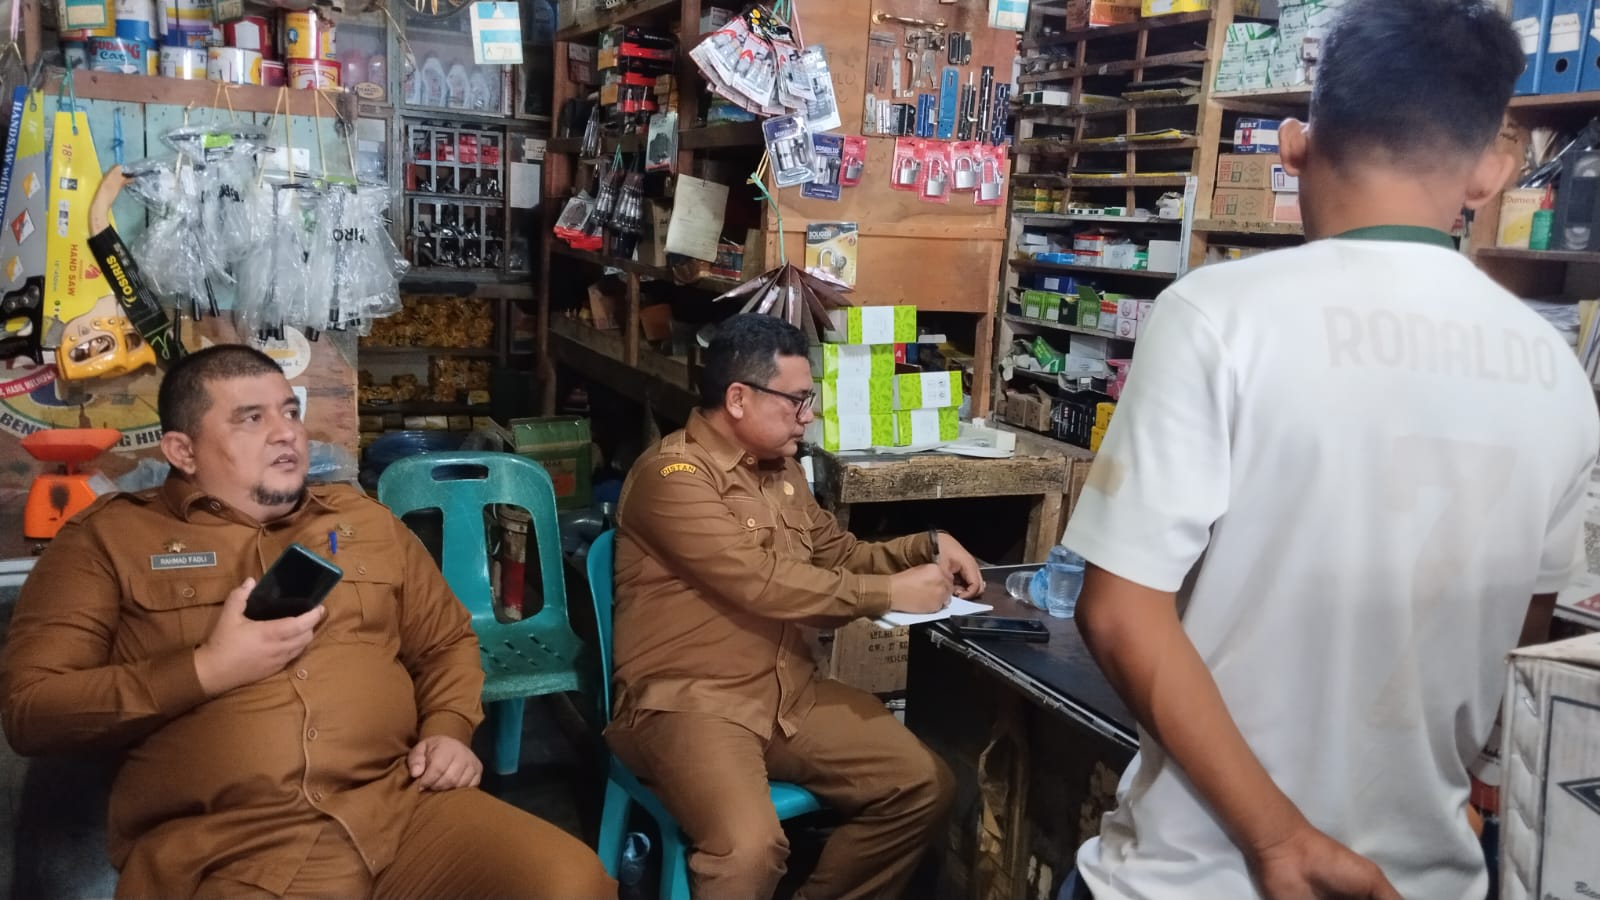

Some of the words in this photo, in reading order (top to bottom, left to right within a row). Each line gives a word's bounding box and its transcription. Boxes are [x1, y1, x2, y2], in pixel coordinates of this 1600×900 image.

[4, 101, 23, 164] HANDSAW
[68, 243, 79, 272] HAND
[67, 273, 77, 297] SAW
[106, 255, 133, 296] OSIRIS
[1322, 305, 1559, 392] RONALDO
[660, 463, 697, 477] DISTAN
[160, 557, 187, 566] RAHMAD
[188, 556, 207, 564] FADLI
